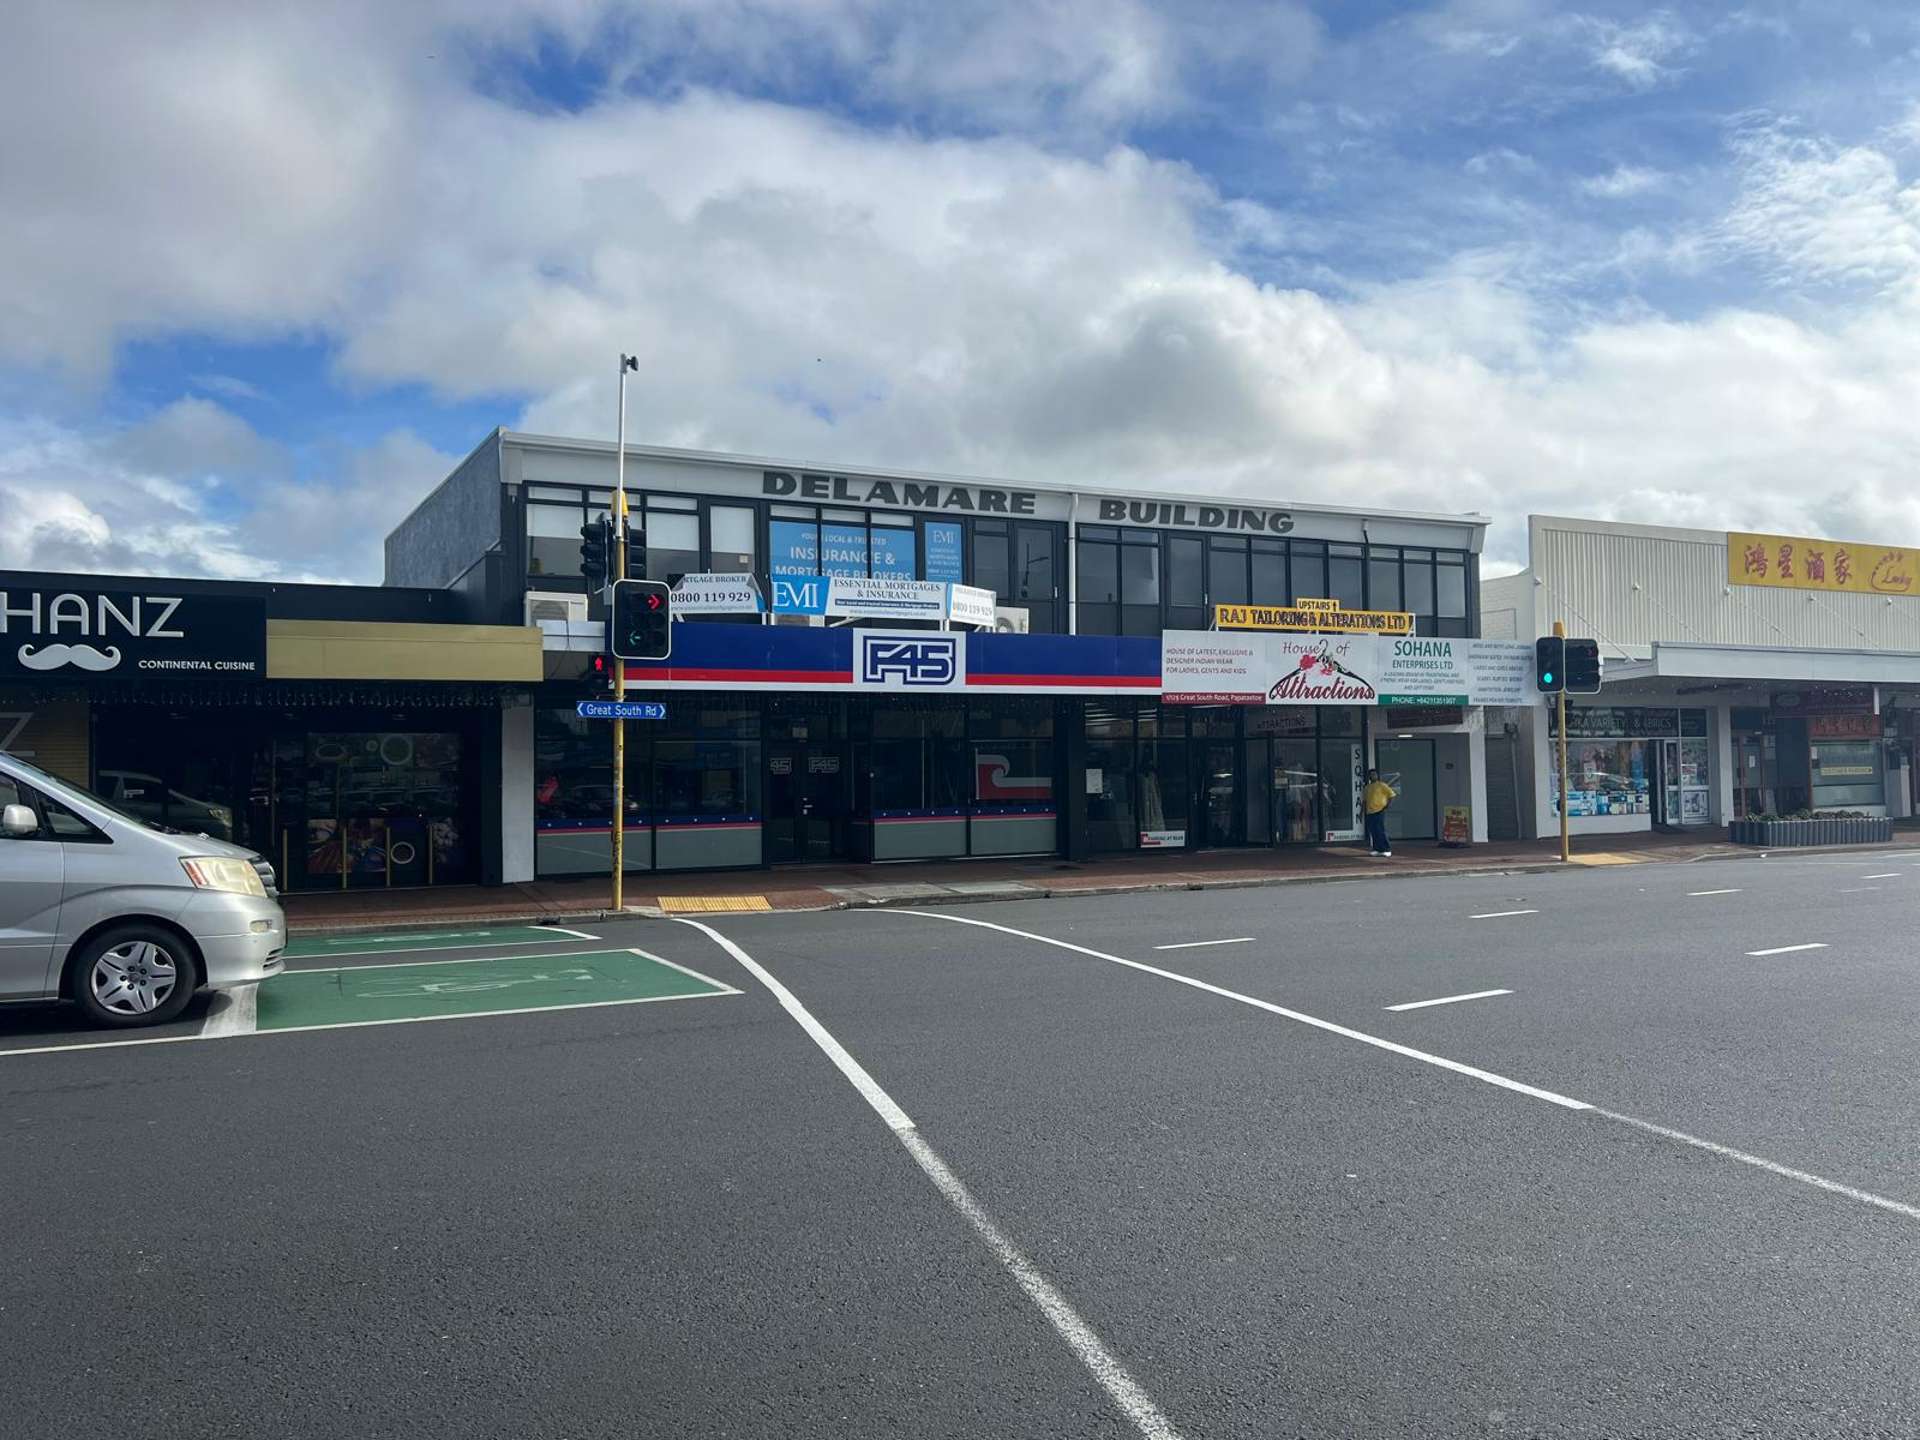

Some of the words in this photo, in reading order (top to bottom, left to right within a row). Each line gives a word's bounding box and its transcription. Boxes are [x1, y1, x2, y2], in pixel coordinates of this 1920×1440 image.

[763, 471, 1036, 514] DELAMARE
[1100, 499, 1295, 534] BUILDING
[790, 547, 881, 565] INSURANCE
[884, 553, 896, 565] &
[834, 579, 882, 589] ESSENTIAL
[885, 581, 941, 593] MORTGAGES
[671, 592, 701, 603] 0800
[705, 592, 726, 602] 119
[728, 591, 751, 602] 929
[772, 581, 819, 609] EMI
[856, 590, 864, 598] &
[866, 591, 919, 600] INSURANCE
[1299, 600, 1330, 611] UPSTAIRS
[0, 592, 184, 637] HANZ
[1220, 608, 1247, 624] RAJ
[1250, 609, 1309, 626] TAILORING
[1319, 611, 1386, 629] ALTERATIONS
[1387, 615, 1405, 630] LTD
[1283, 642, 1321, 654] House
[1336, 640, 1350, 657] of
[1394, 640, 1452, 658] SOHANA
[138, 660, 212, 670] CONTINENTAL
[214, 661, 256, 671] CUISINE
[863, 635, 956, 685] F45
[1392, 659, 1439, 669] ENTERPRISES
[1439, 661, 1453, 670] LTD
[1276, 673, 1373, 700] Attractions
[587, 704, 612, 716] Great
[615, 705, 642, 716] South
[645, 706, 657, 717] Rd
